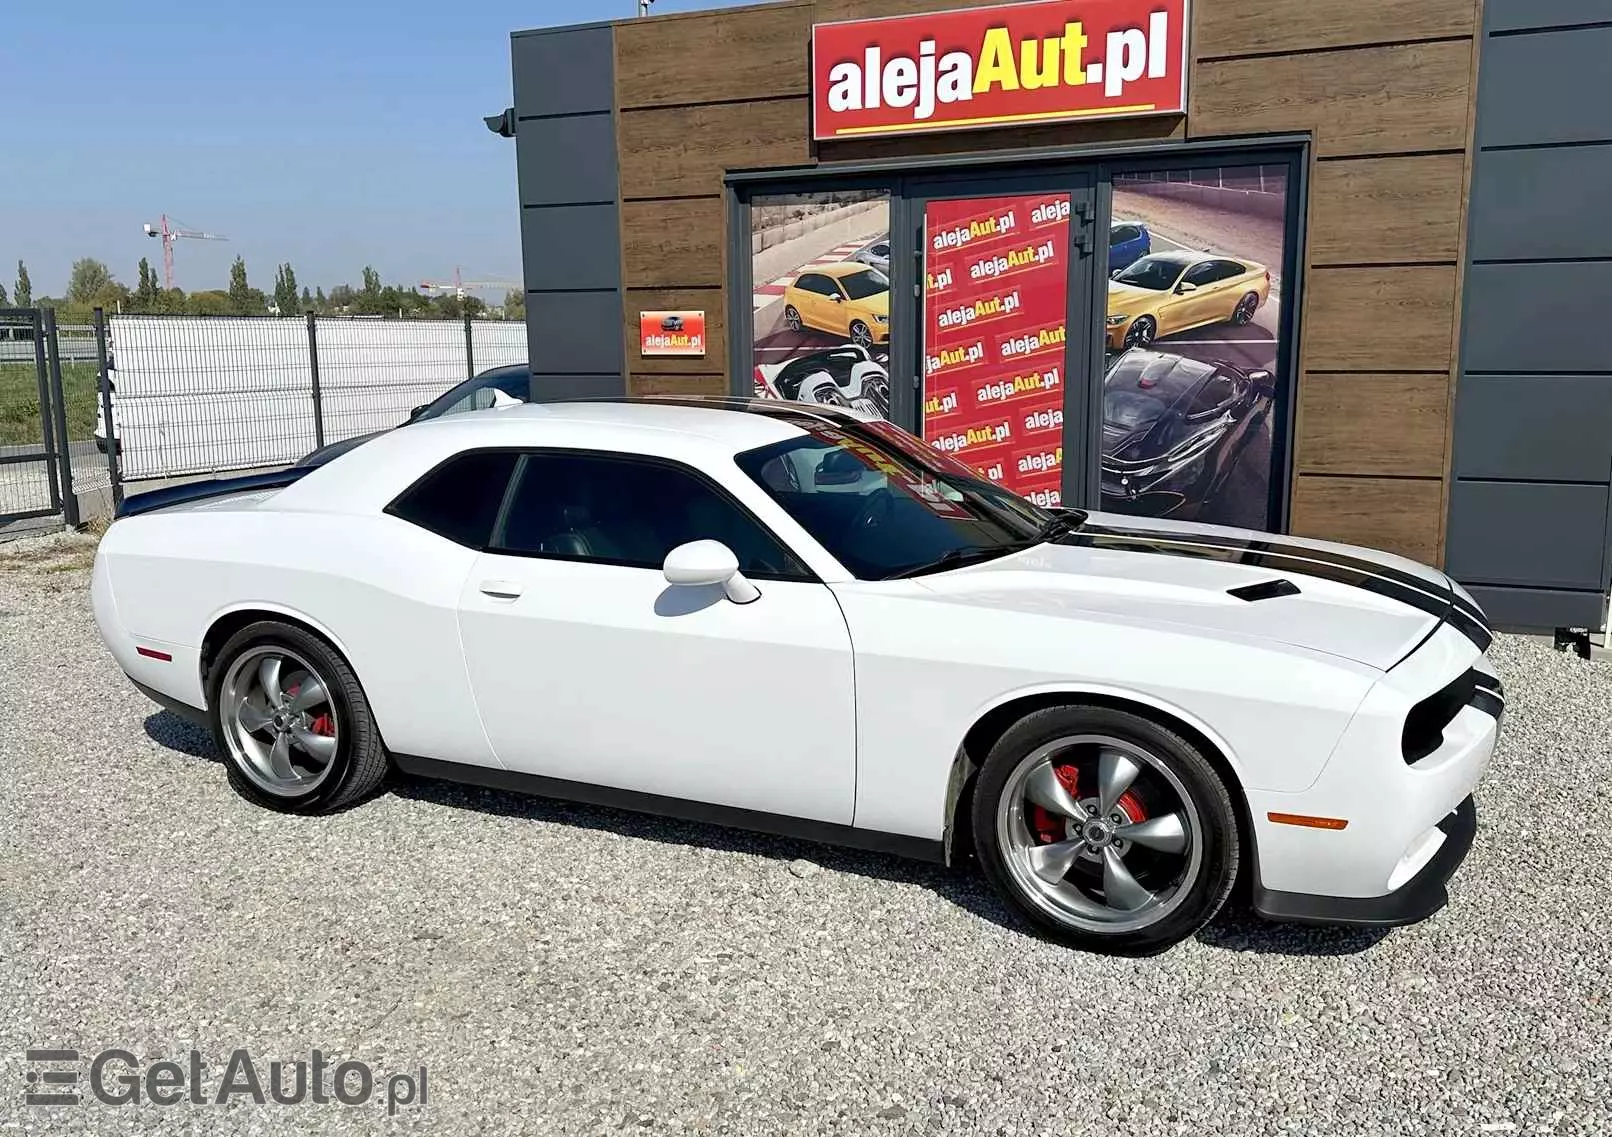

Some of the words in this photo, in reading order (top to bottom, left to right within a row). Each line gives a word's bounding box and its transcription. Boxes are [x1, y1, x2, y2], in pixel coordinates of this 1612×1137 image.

[826, 11, 1169, 119] alejaAut.pl
[1031, 199, 1070, 223] aleja
[933, 210, 1016, 249] alejaAut.pl
[970, 240, 1055, 279] alejaAut.pl
[926, 268, 953, 290] t.pl
[938, 291, 1020, 327] alejaAut.pl
[646, 334, 702, 348] alejaAut.pl
[1001, 326, 1066, 356] alejaAut
[977, 367, 1060, 402] alejaAut.pl
[1025, 409, 1063, 429] aleja
